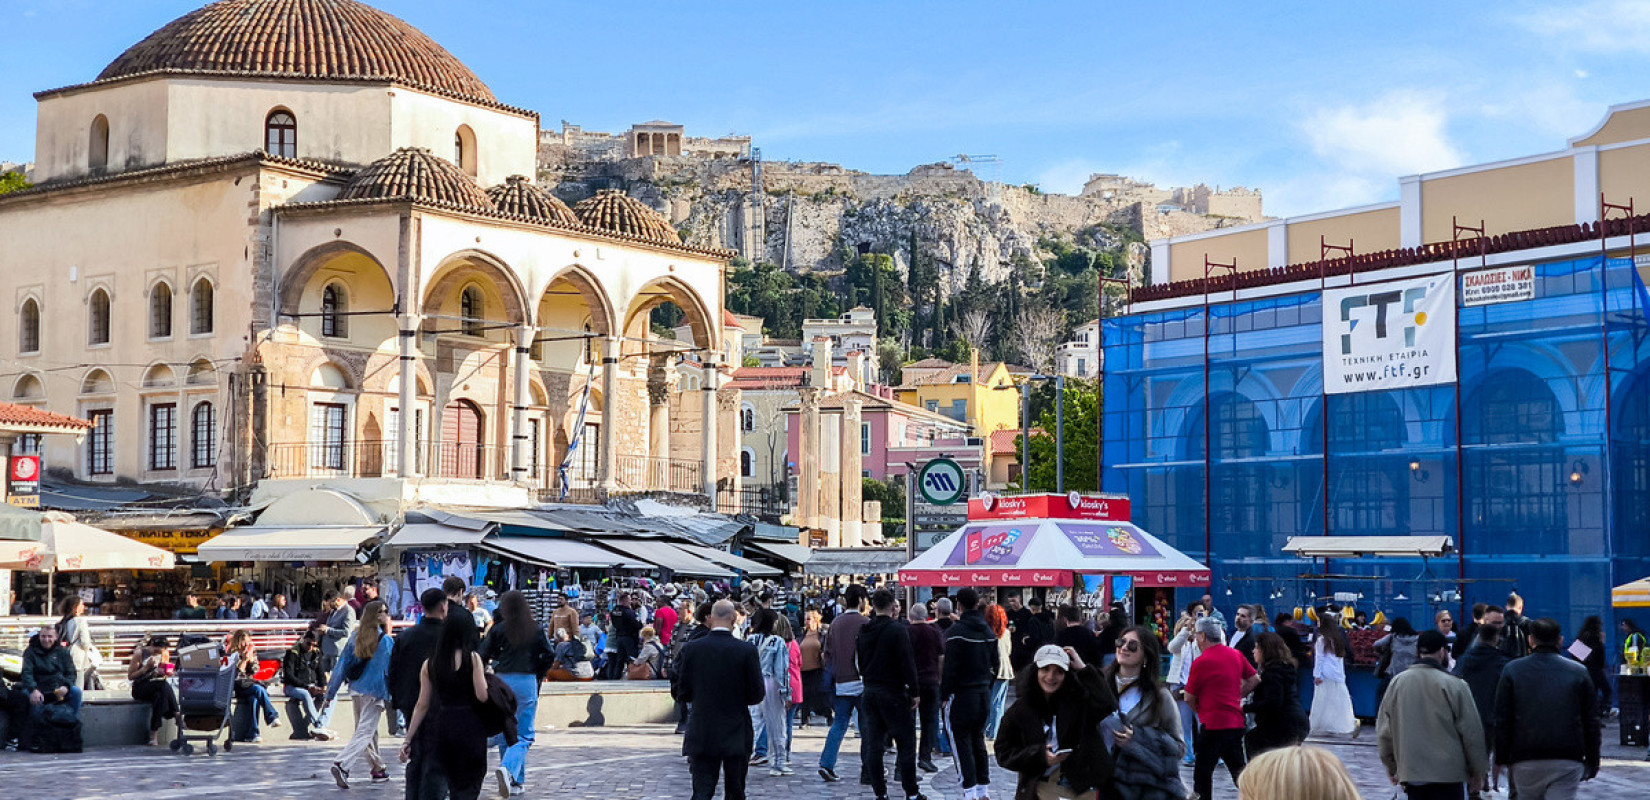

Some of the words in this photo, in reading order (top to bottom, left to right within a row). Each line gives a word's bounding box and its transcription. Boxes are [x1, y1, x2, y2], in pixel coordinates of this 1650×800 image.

[1342, 355, 1383, 366] ΤΕΧΝΙΚΗ
[1389, 350, 1429, 361] ΕΤΑΙΡΙΑ
[1343, 363, 1430, 383] www.ftf.gr
[999, 499, 1026, 509] kiosky's
[1080, 500, 1108, 510] kiosky's
